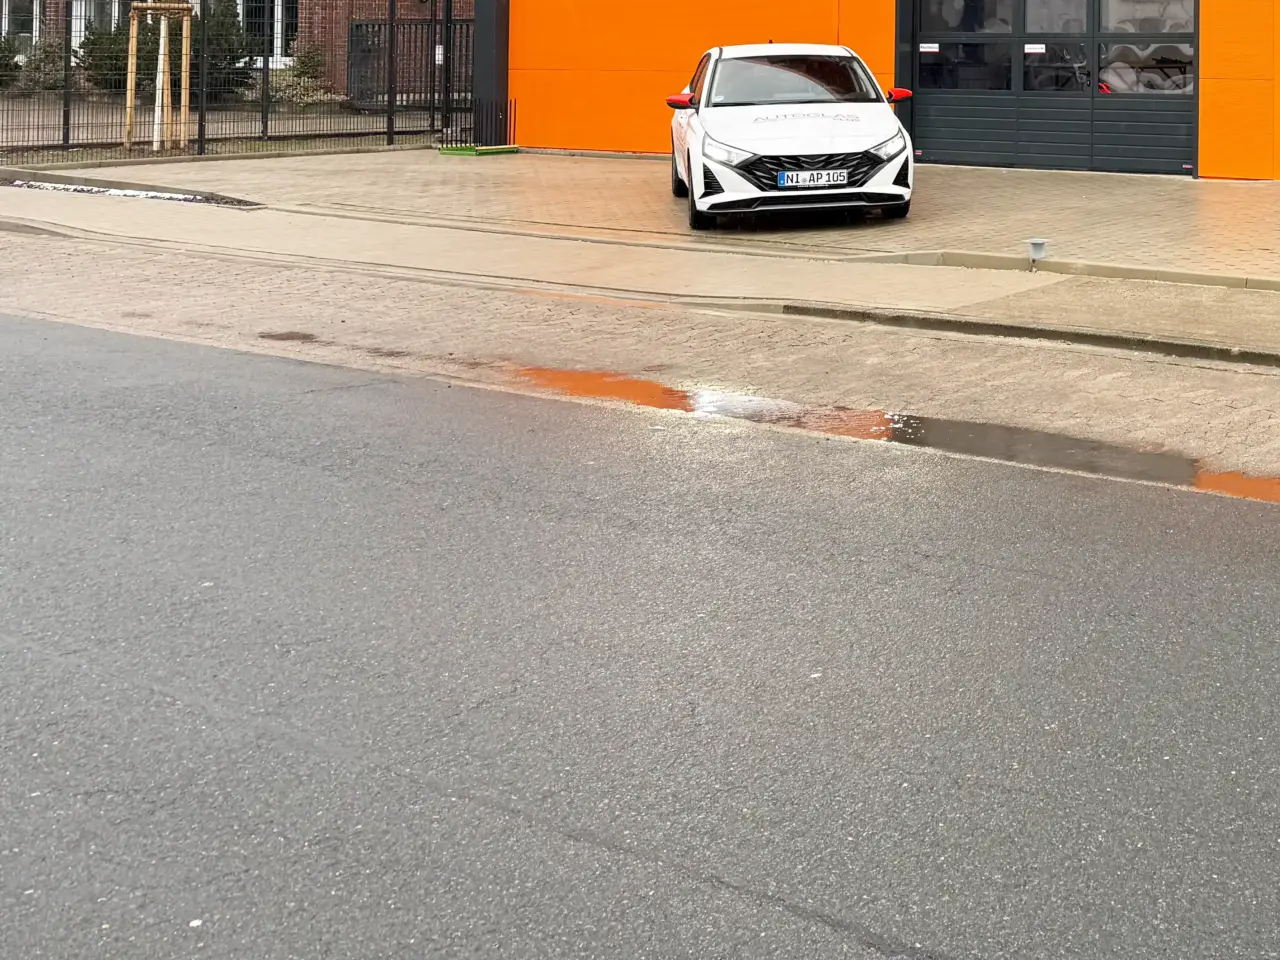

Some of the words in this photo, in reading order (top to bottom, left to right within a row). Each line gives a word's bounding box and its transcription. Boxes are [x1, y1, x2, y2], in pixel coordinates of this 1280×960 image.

[786, 173, 800, 184] NI
[808, 172, 823, 184] AP
[825, 171, 846, 183] 105
